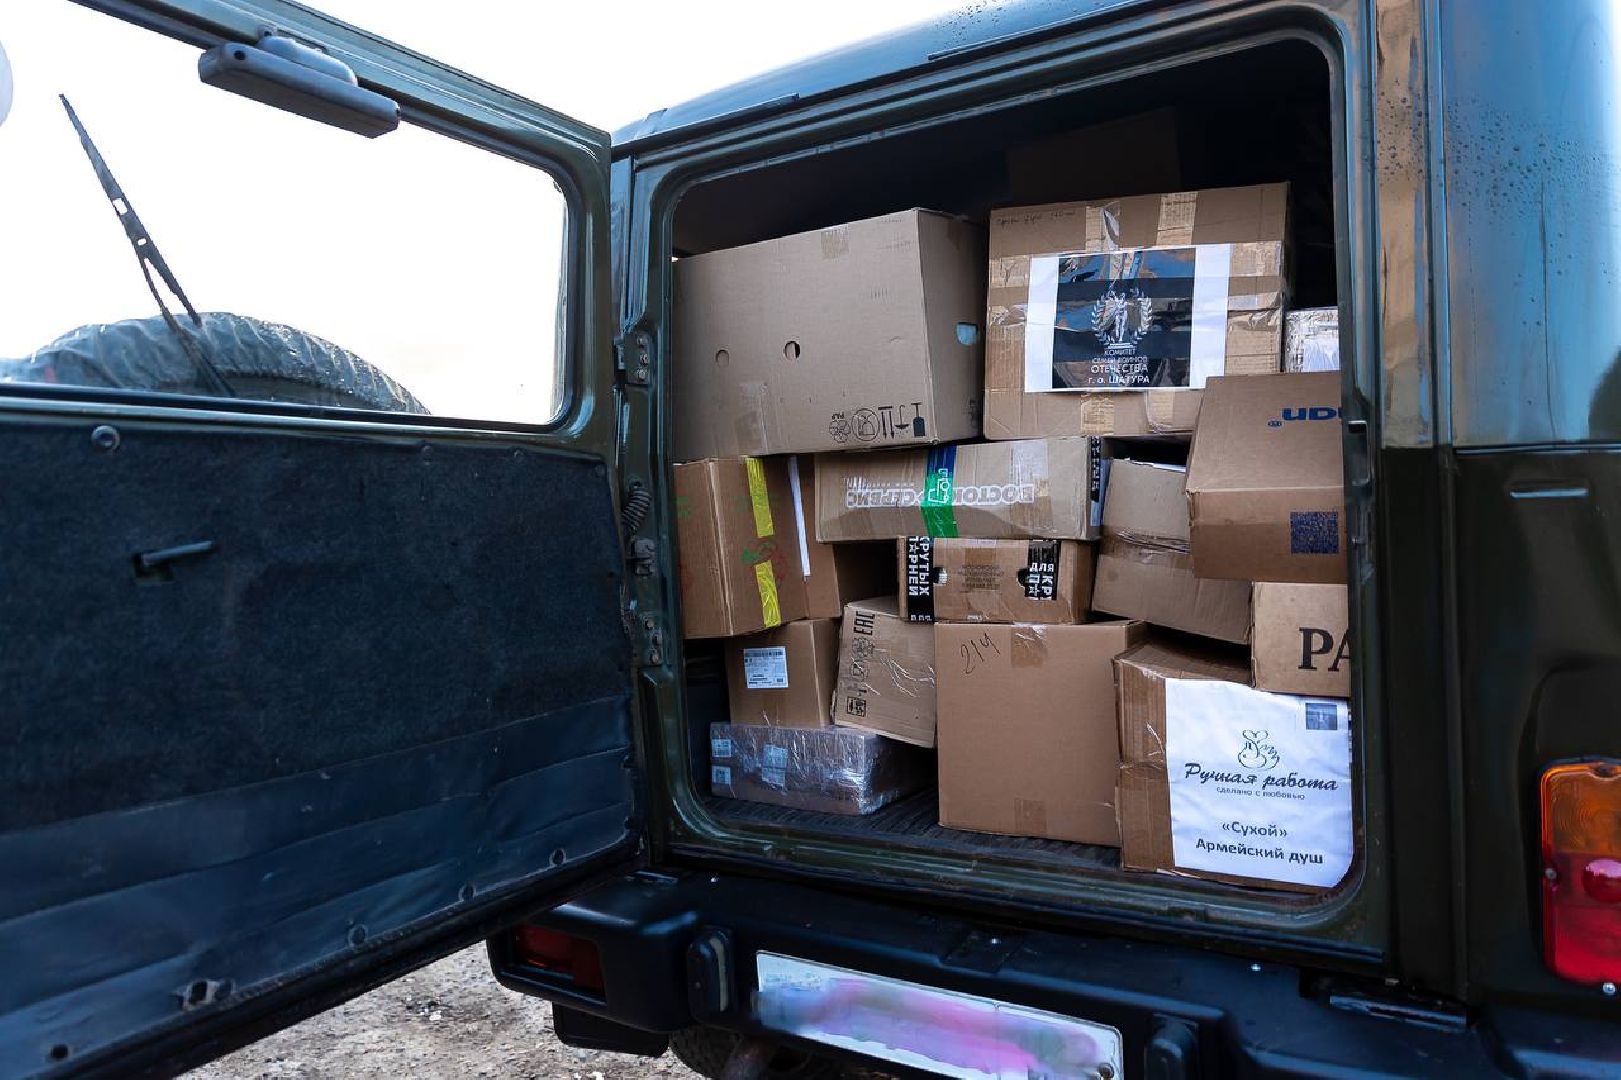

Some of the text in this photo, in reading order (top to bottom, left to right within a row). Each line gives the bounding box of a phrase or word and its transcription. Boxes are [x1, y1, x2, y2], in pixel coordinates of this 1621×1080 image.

[1104, 348, 1137, 356] КОМИТЕТ
[1091, 363, 1149, 374] ОТЕЧЕСТВА
[1108, 375, 1150, 384] ШАТУРА
[1184, 762, 1339, 791] Ручная работа
[1216, 786, 1253, 796] сделано
[1262, 790, 1306, 800] любовью
[1222, 821, 1288, 837] «Сухой»
[1195, 838, 1324, 865] Армейский душ
